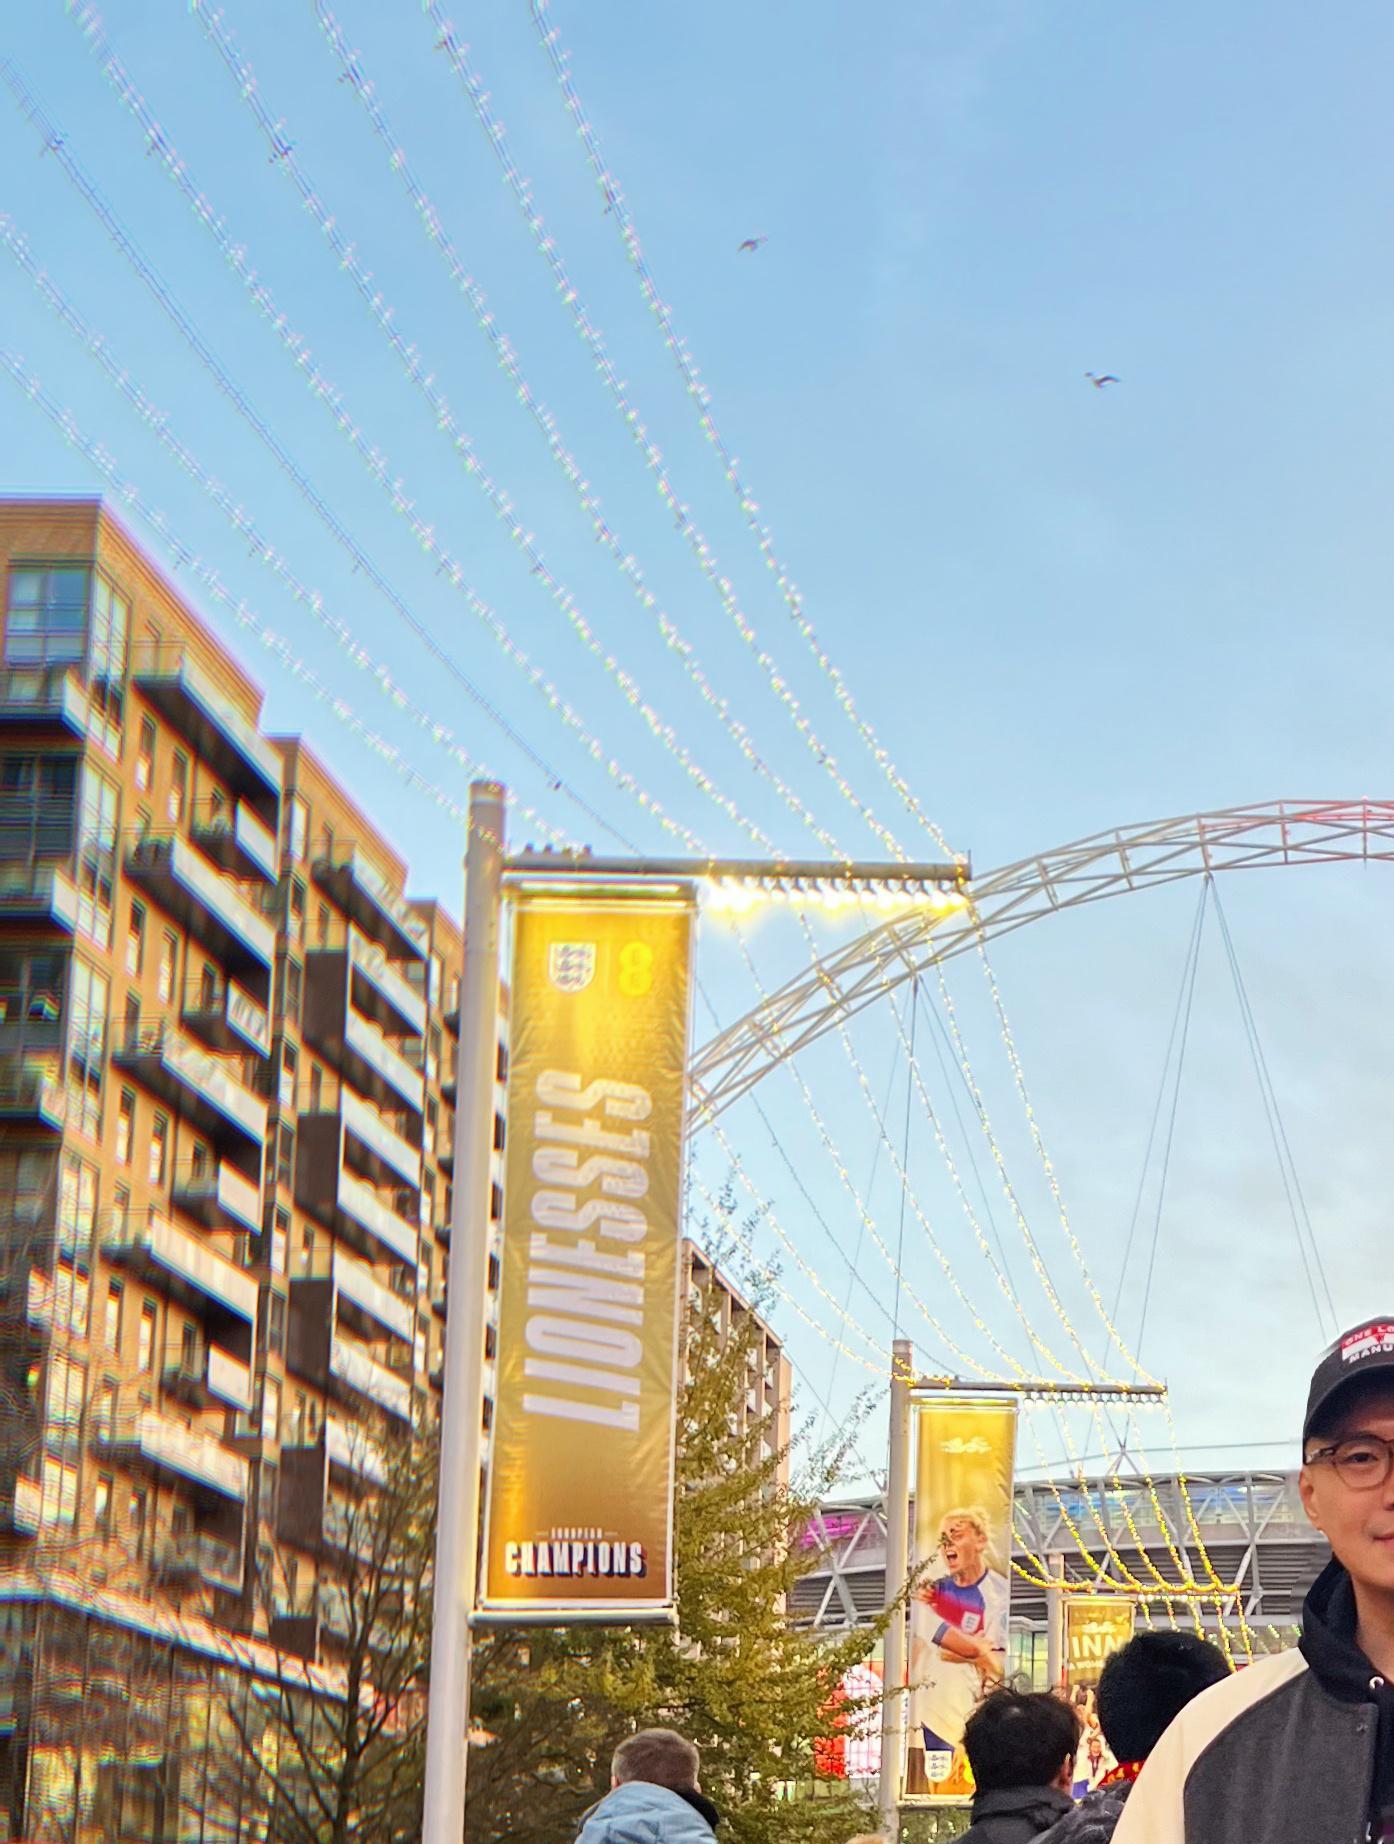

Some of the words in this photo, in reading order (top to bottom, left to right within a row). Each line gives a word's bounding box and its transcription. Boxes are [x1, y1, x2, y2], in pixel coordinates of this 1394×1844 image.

[523, 1068, 653, 1432] LIONESSES
[1344, 1328, 1372, 1346] ONE
[505, 1541, 646, 1577] CHAMPIONS
